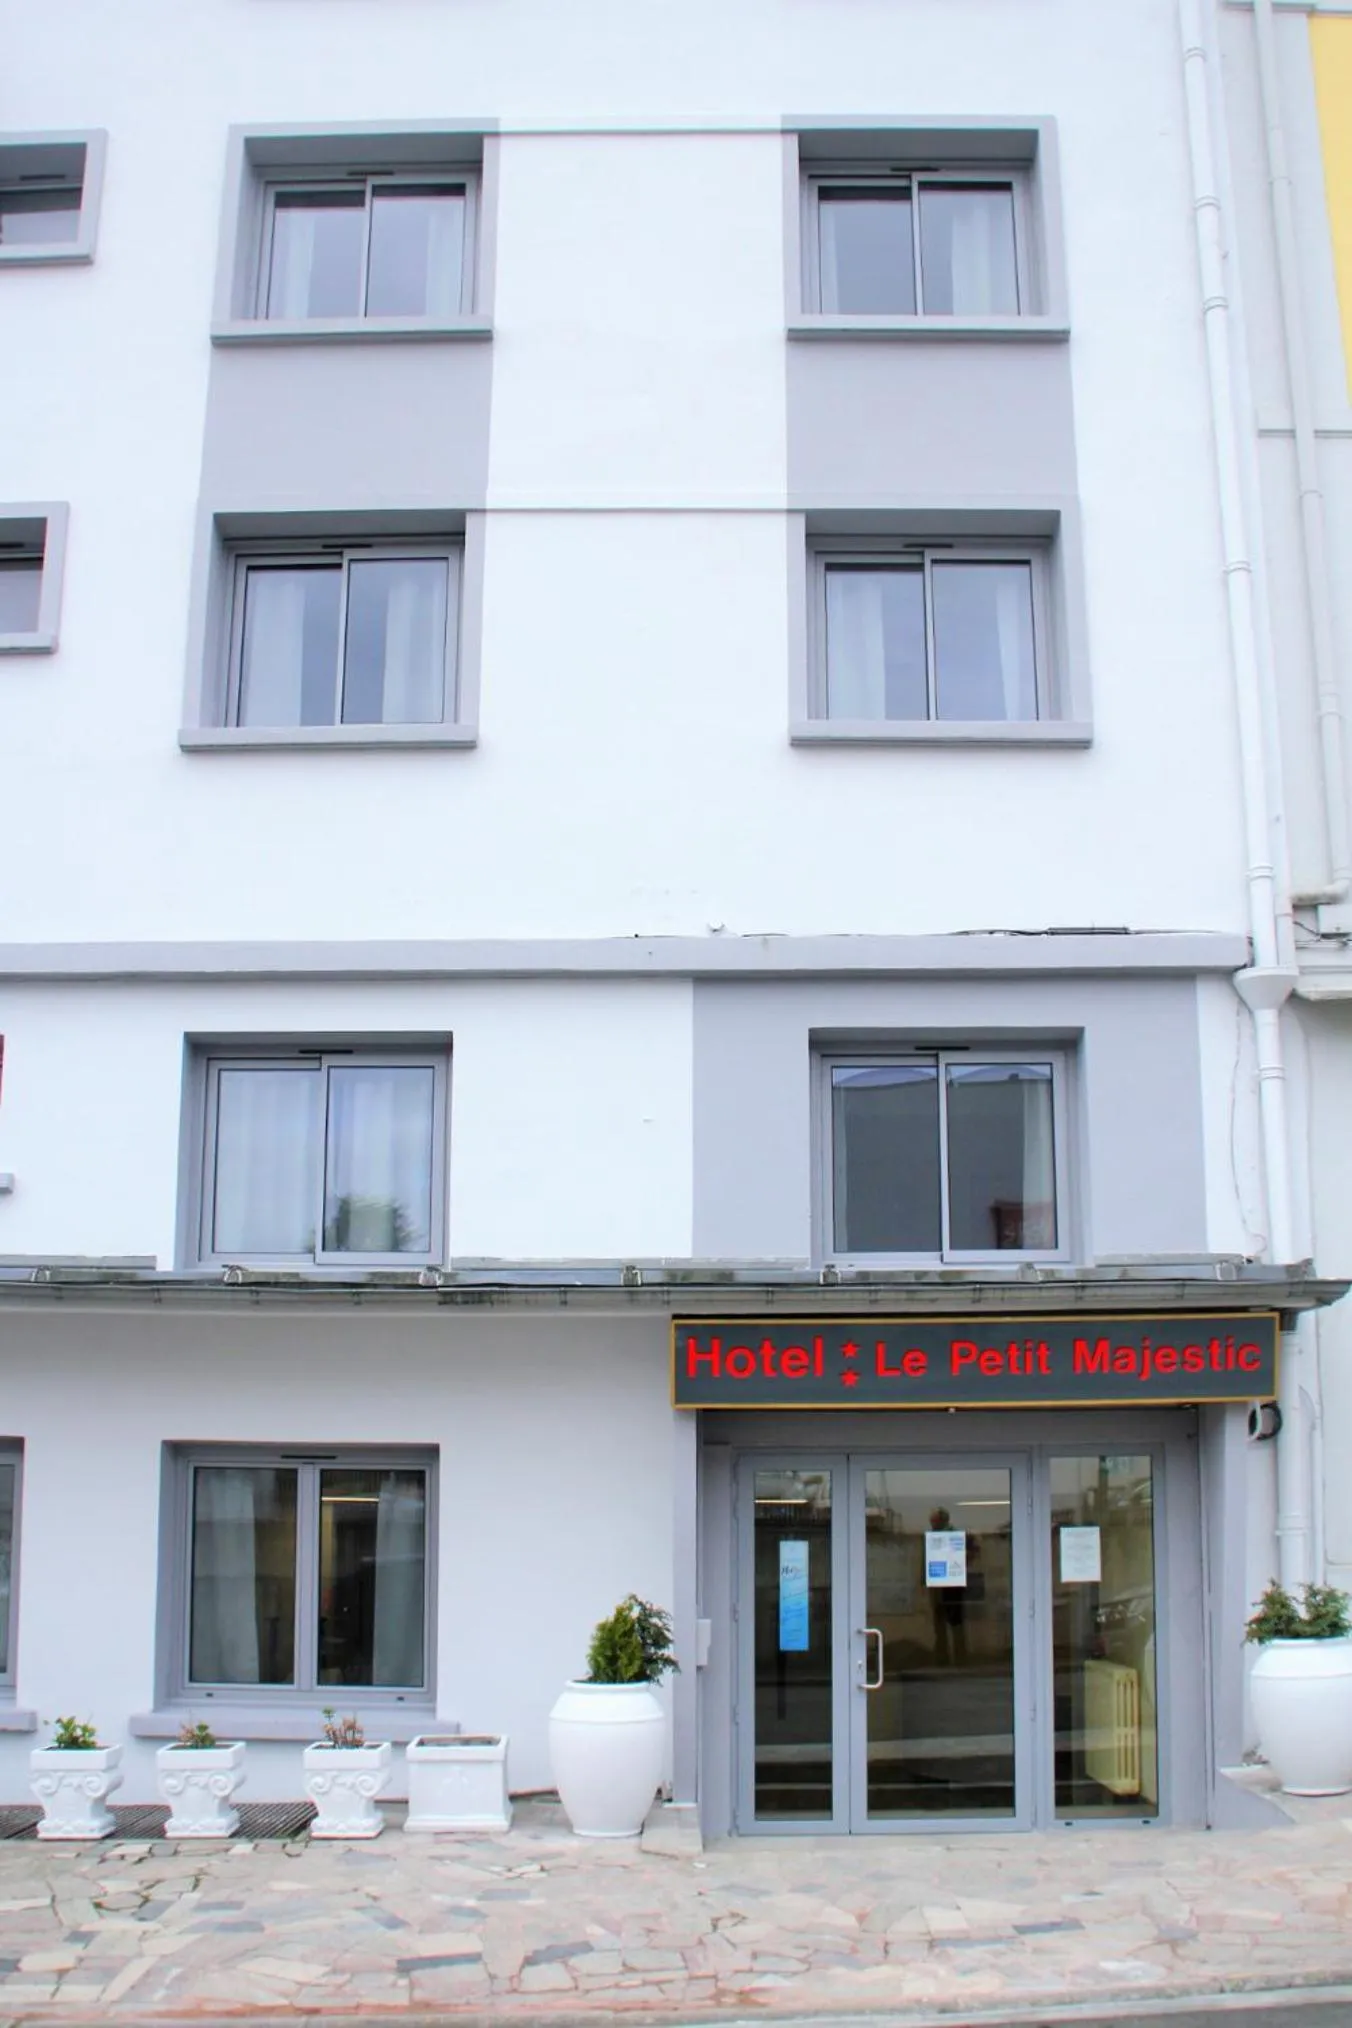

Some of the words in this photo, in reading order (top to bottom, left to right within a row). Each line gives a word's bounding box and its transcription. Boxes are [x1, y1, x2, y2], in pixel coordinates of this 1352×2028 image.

[686, 1337, 825, 1378] Hotel
[876, 1342, 928, 1378] Le
[950, 1341, 1051, 1377] Petit
[1073, 1337, 1262, 1381] Majestic
